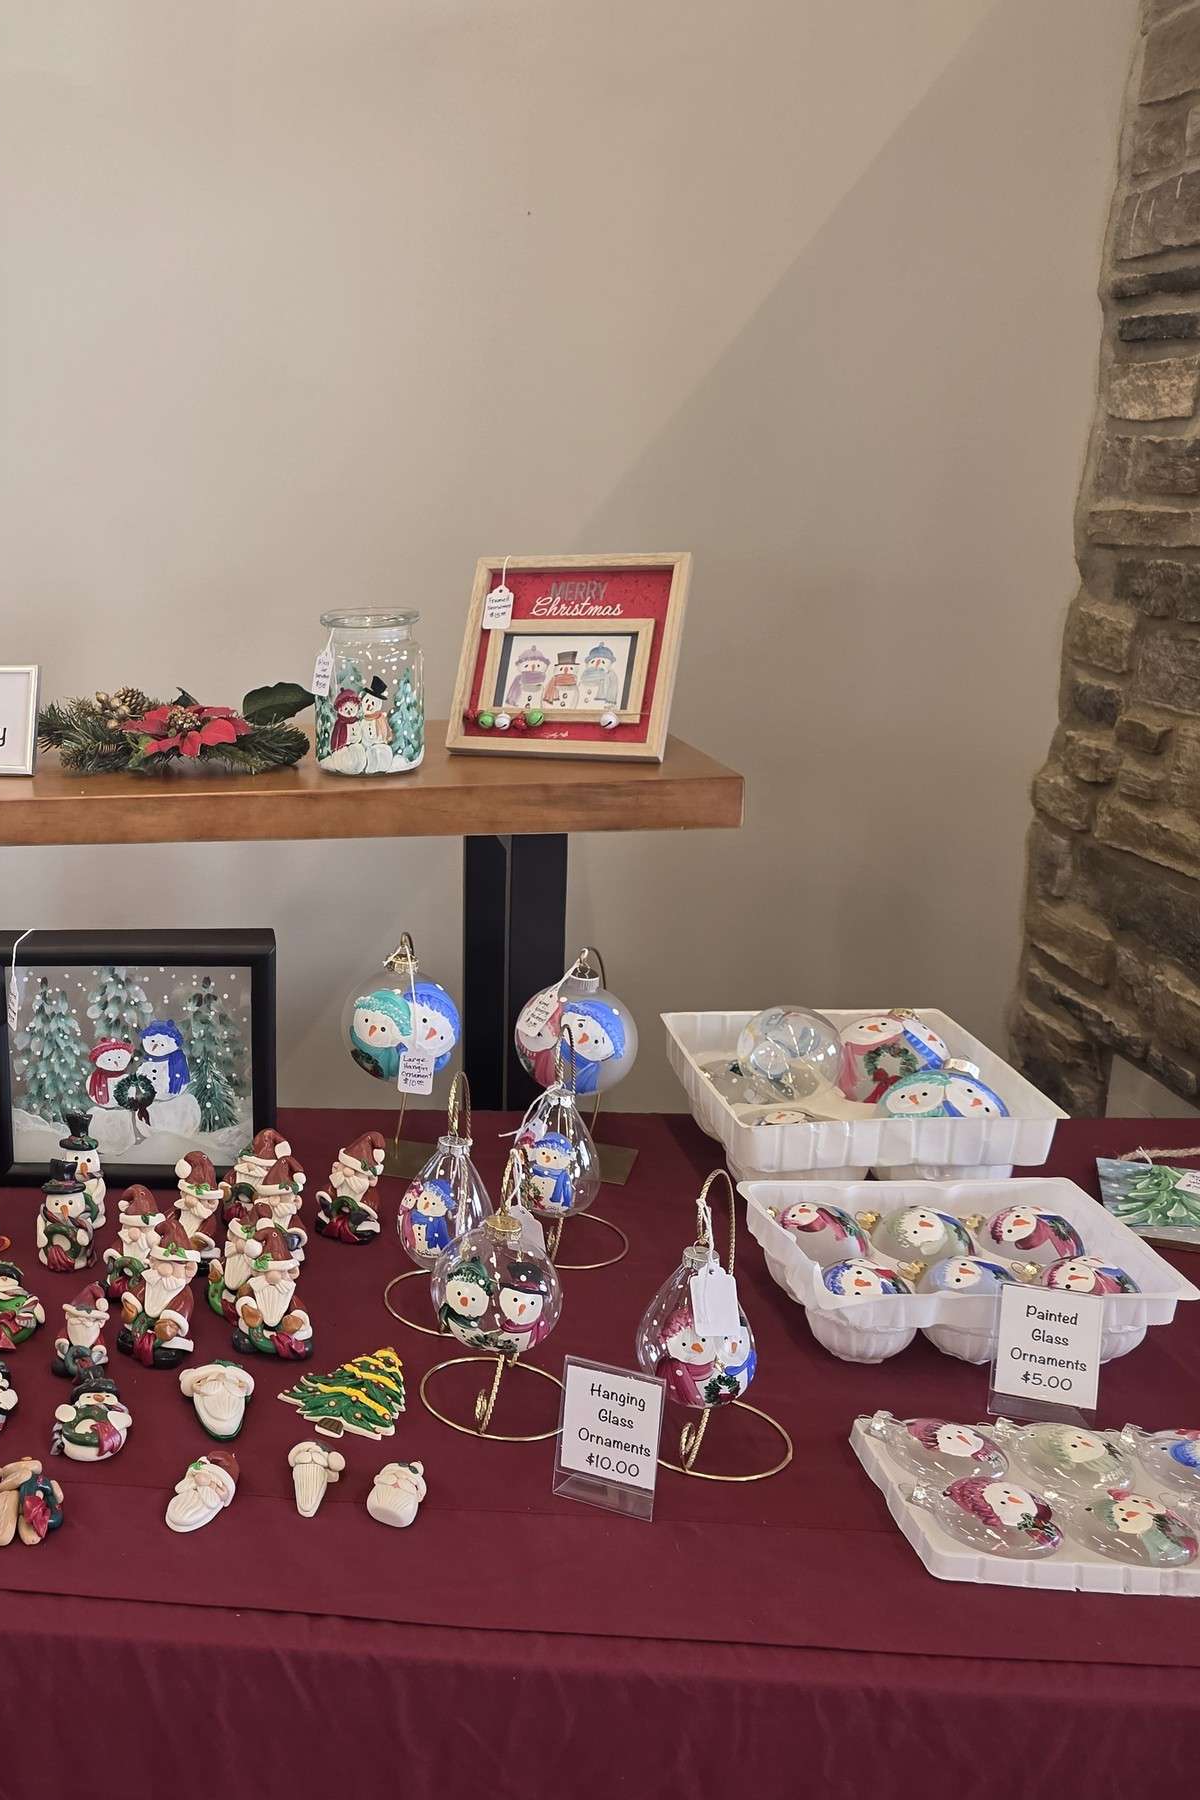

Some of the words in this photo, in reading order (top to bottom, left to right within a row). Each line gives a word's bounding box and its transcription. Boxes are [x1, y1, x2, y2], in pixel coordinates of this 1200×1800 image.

[551, 580, 608, 601] MERRY
[530, 596, 624, 617] Christmas
[1026, 1304, 1078, 1325] Painted
[1031, 1328, 1069, 1346] Glass
[1010, 1347, 1087, 1372] Ornaments
[1021, 1371, 1073, 1391] $5.00
[590, 1382, 646, 1411] Hanging
[598, 1408, 634, 1429] Glass
[578, 1427, 651, 1457] Ornaments
[586, 1453, 640, 1477] $10.00
